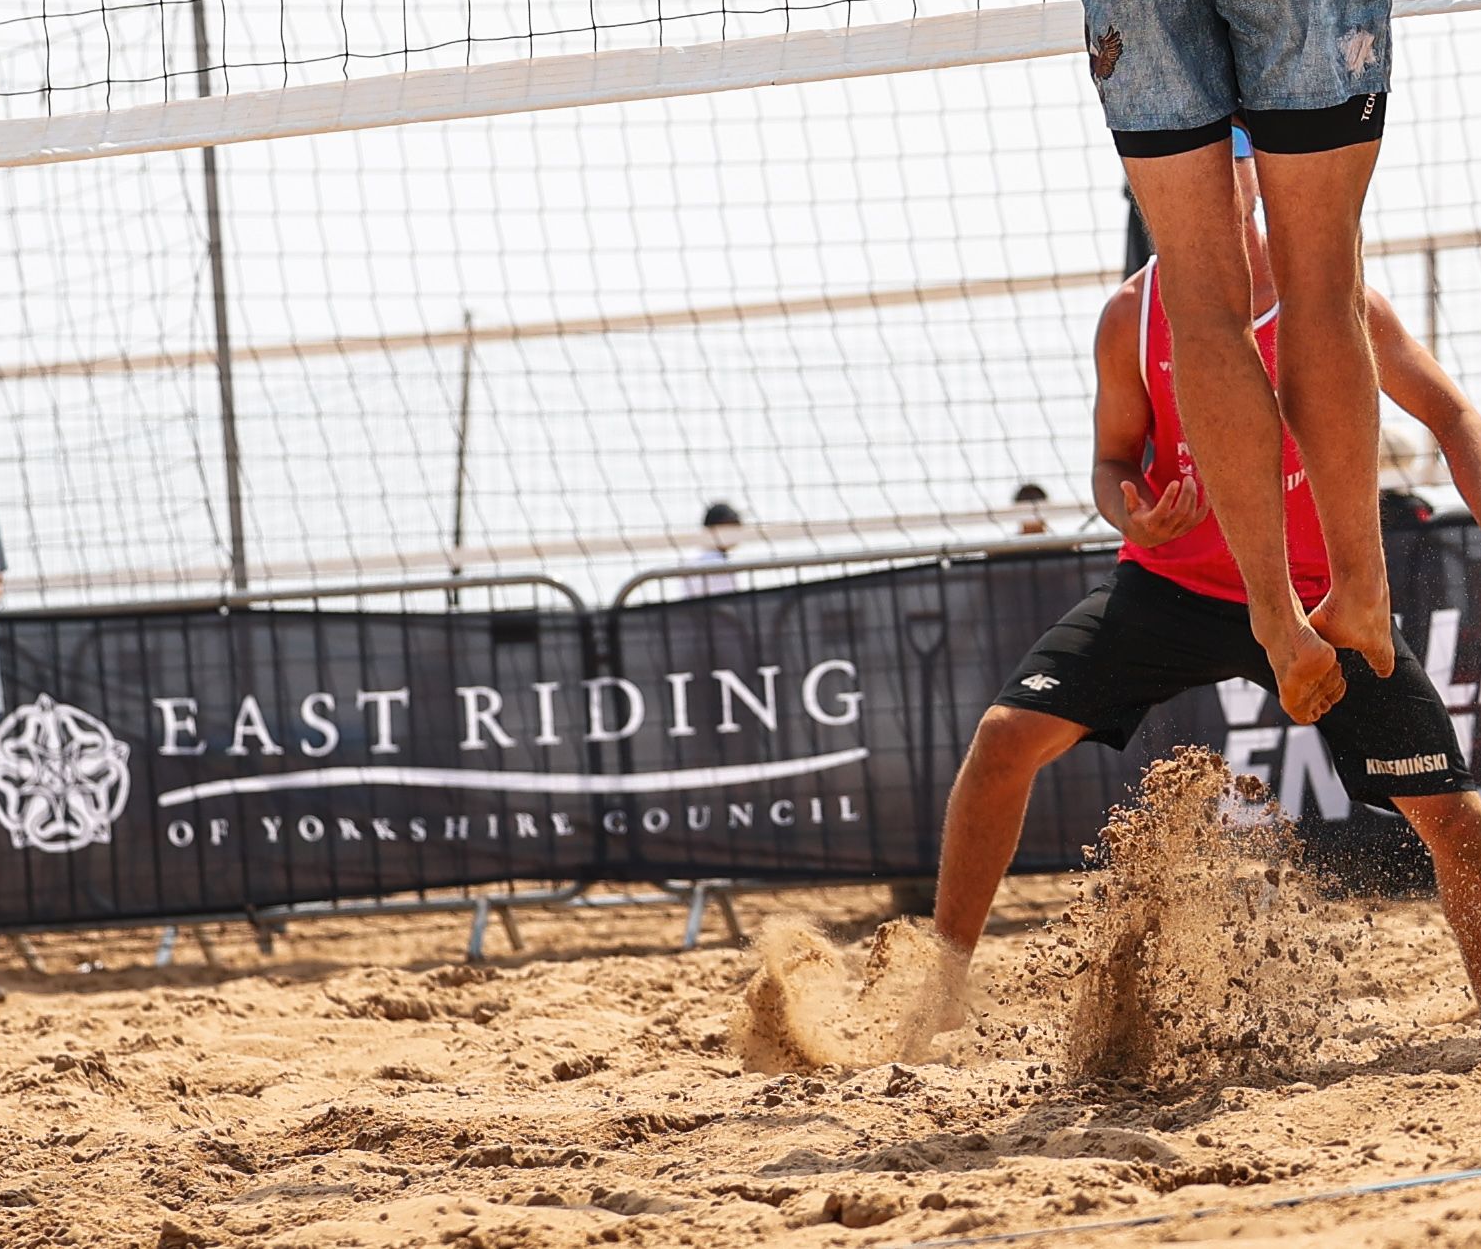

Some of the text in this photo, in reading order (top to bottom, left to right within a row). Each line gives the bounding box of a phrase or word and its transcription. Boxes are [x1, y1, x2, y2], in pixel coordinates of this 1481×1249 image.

[152, 658, 864, 757] EAST RIDING
[168, 795, 861, 848] OF YORKSHIRE COUNCIL
